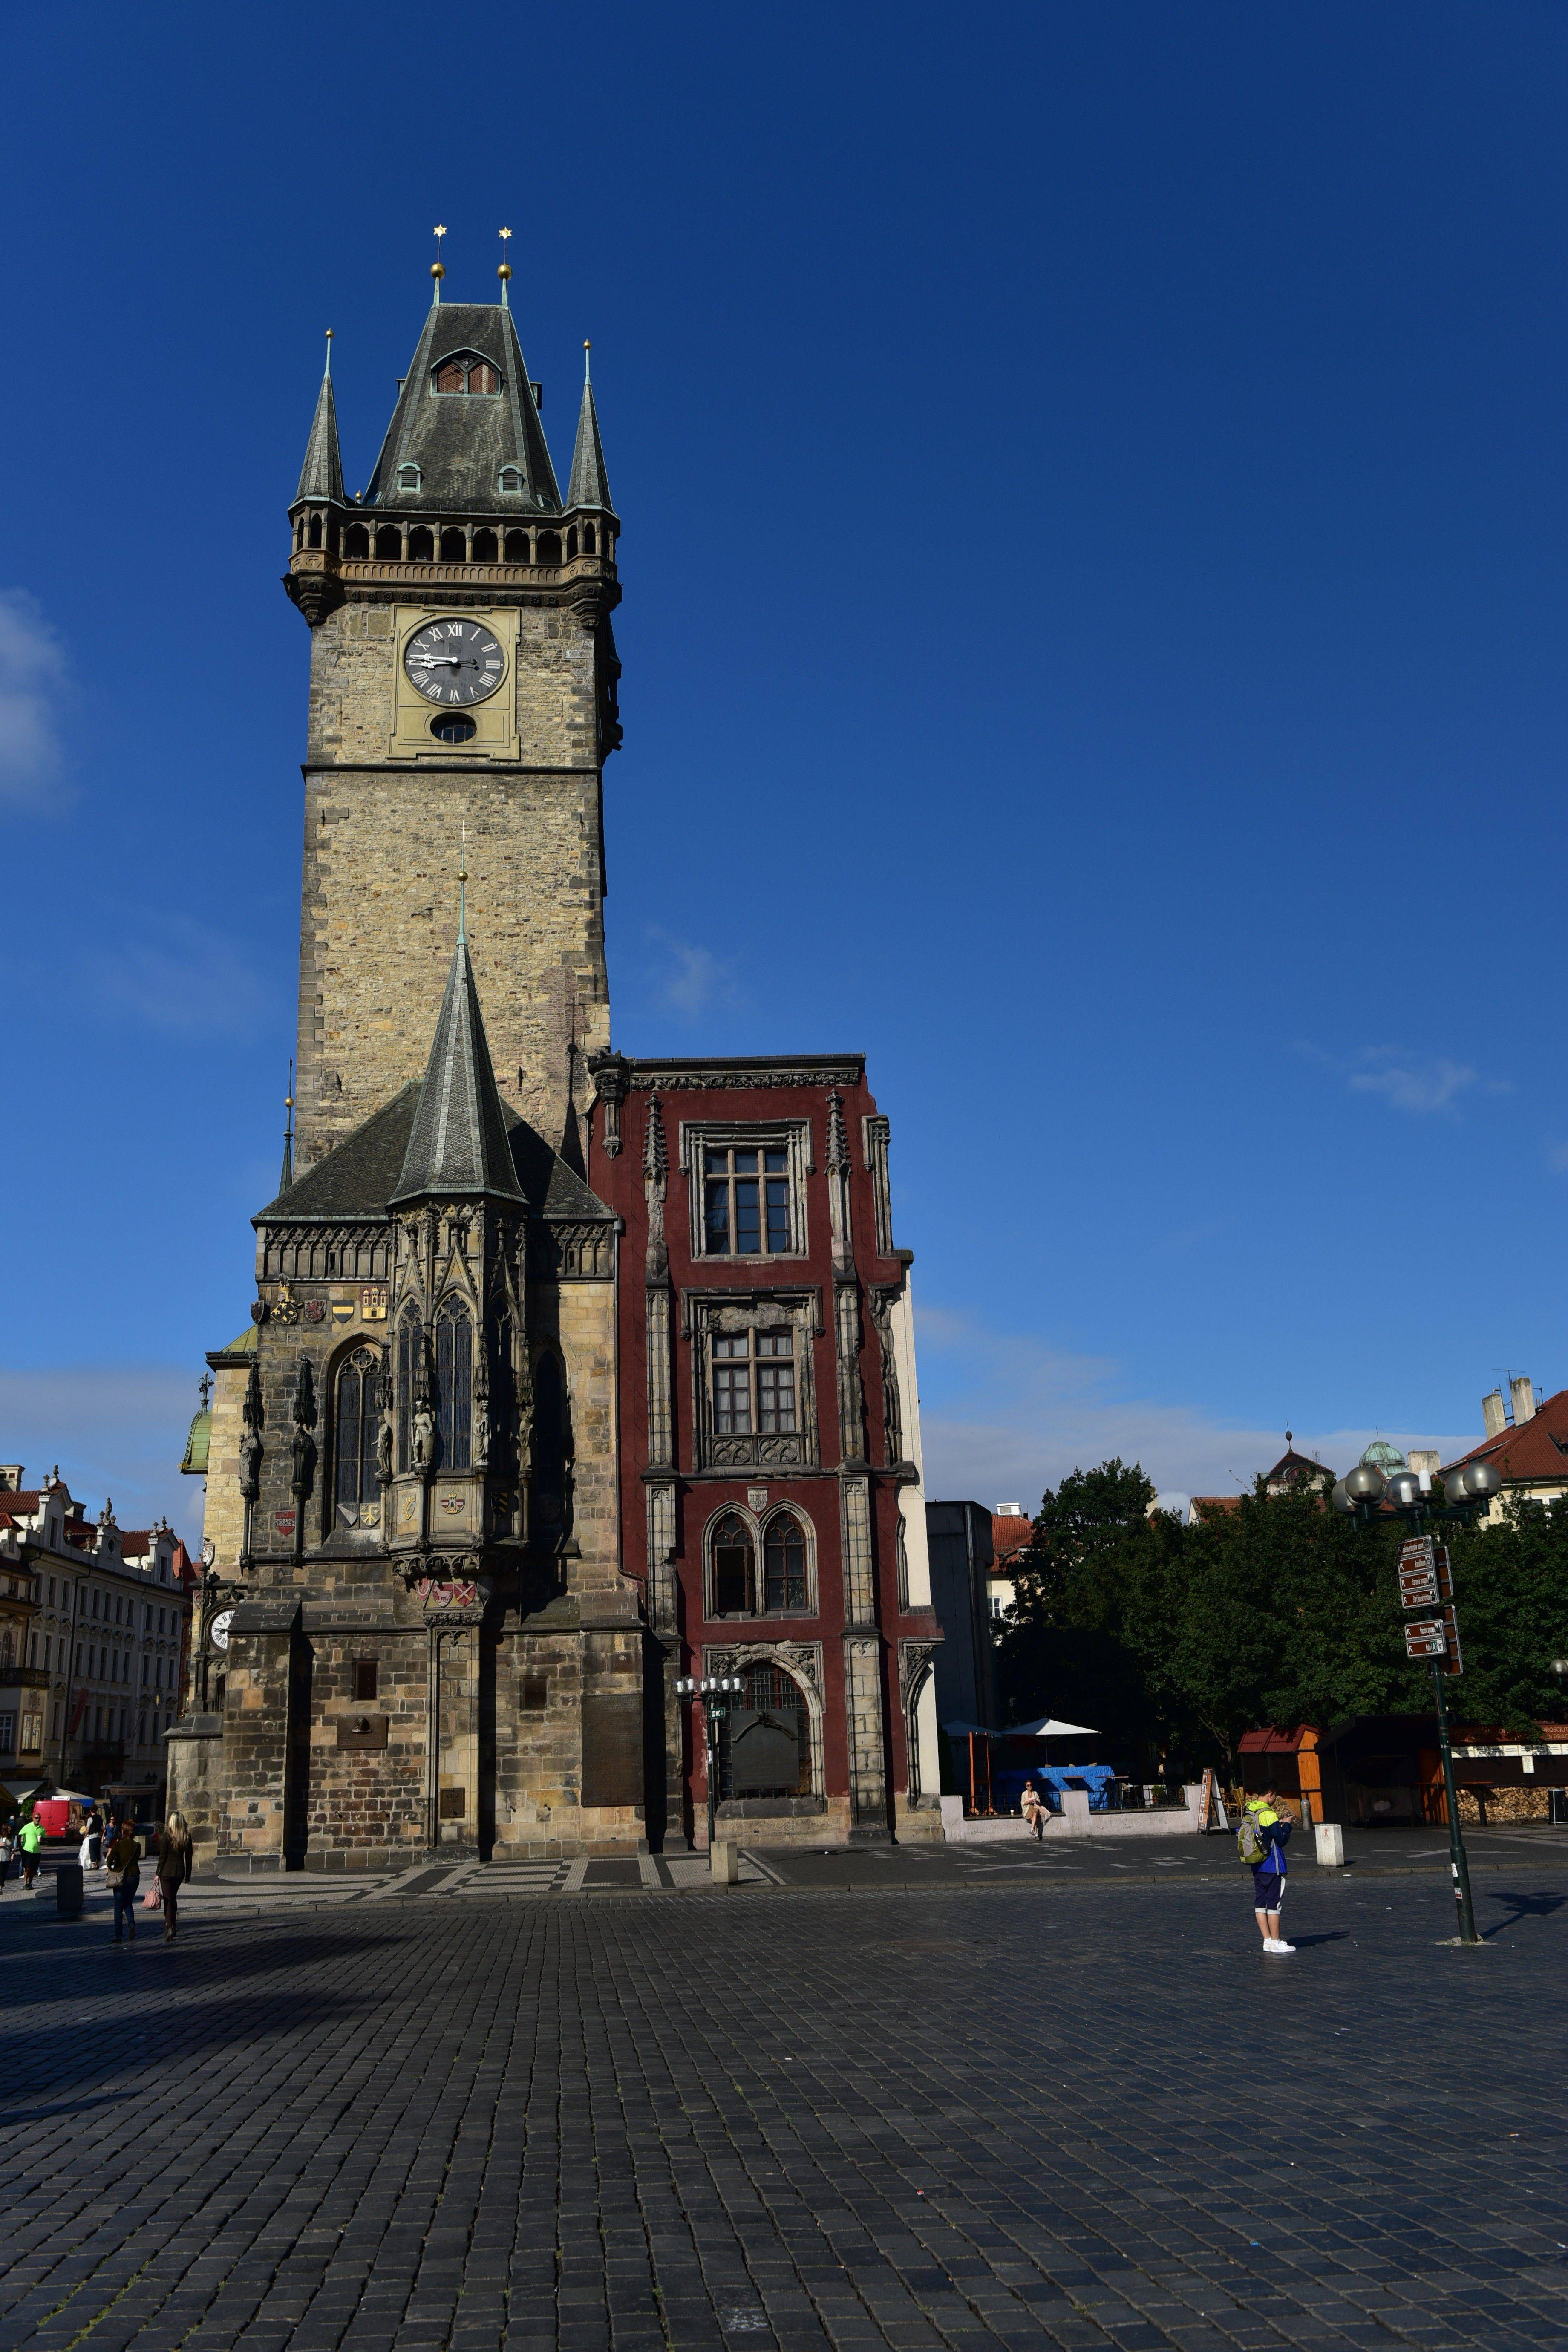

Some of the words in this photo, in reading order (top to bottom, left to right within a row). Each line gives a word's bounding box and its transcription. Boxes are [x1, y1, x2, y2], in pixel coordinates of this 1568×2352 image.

[428, 627, 444, 642] XI
[447, 624, 463, 637] XII
[470, 630, 480, 641] I
[415, 639, 431, 651] X
[481, 643, 496, 653] II
[486, 660, 500, 669] III
[412, 670, 430, 689] VIII
[426, 683, 442, 699] VII
[450, 689, 461, 701] VI
[470, 686, 480, 698] V
